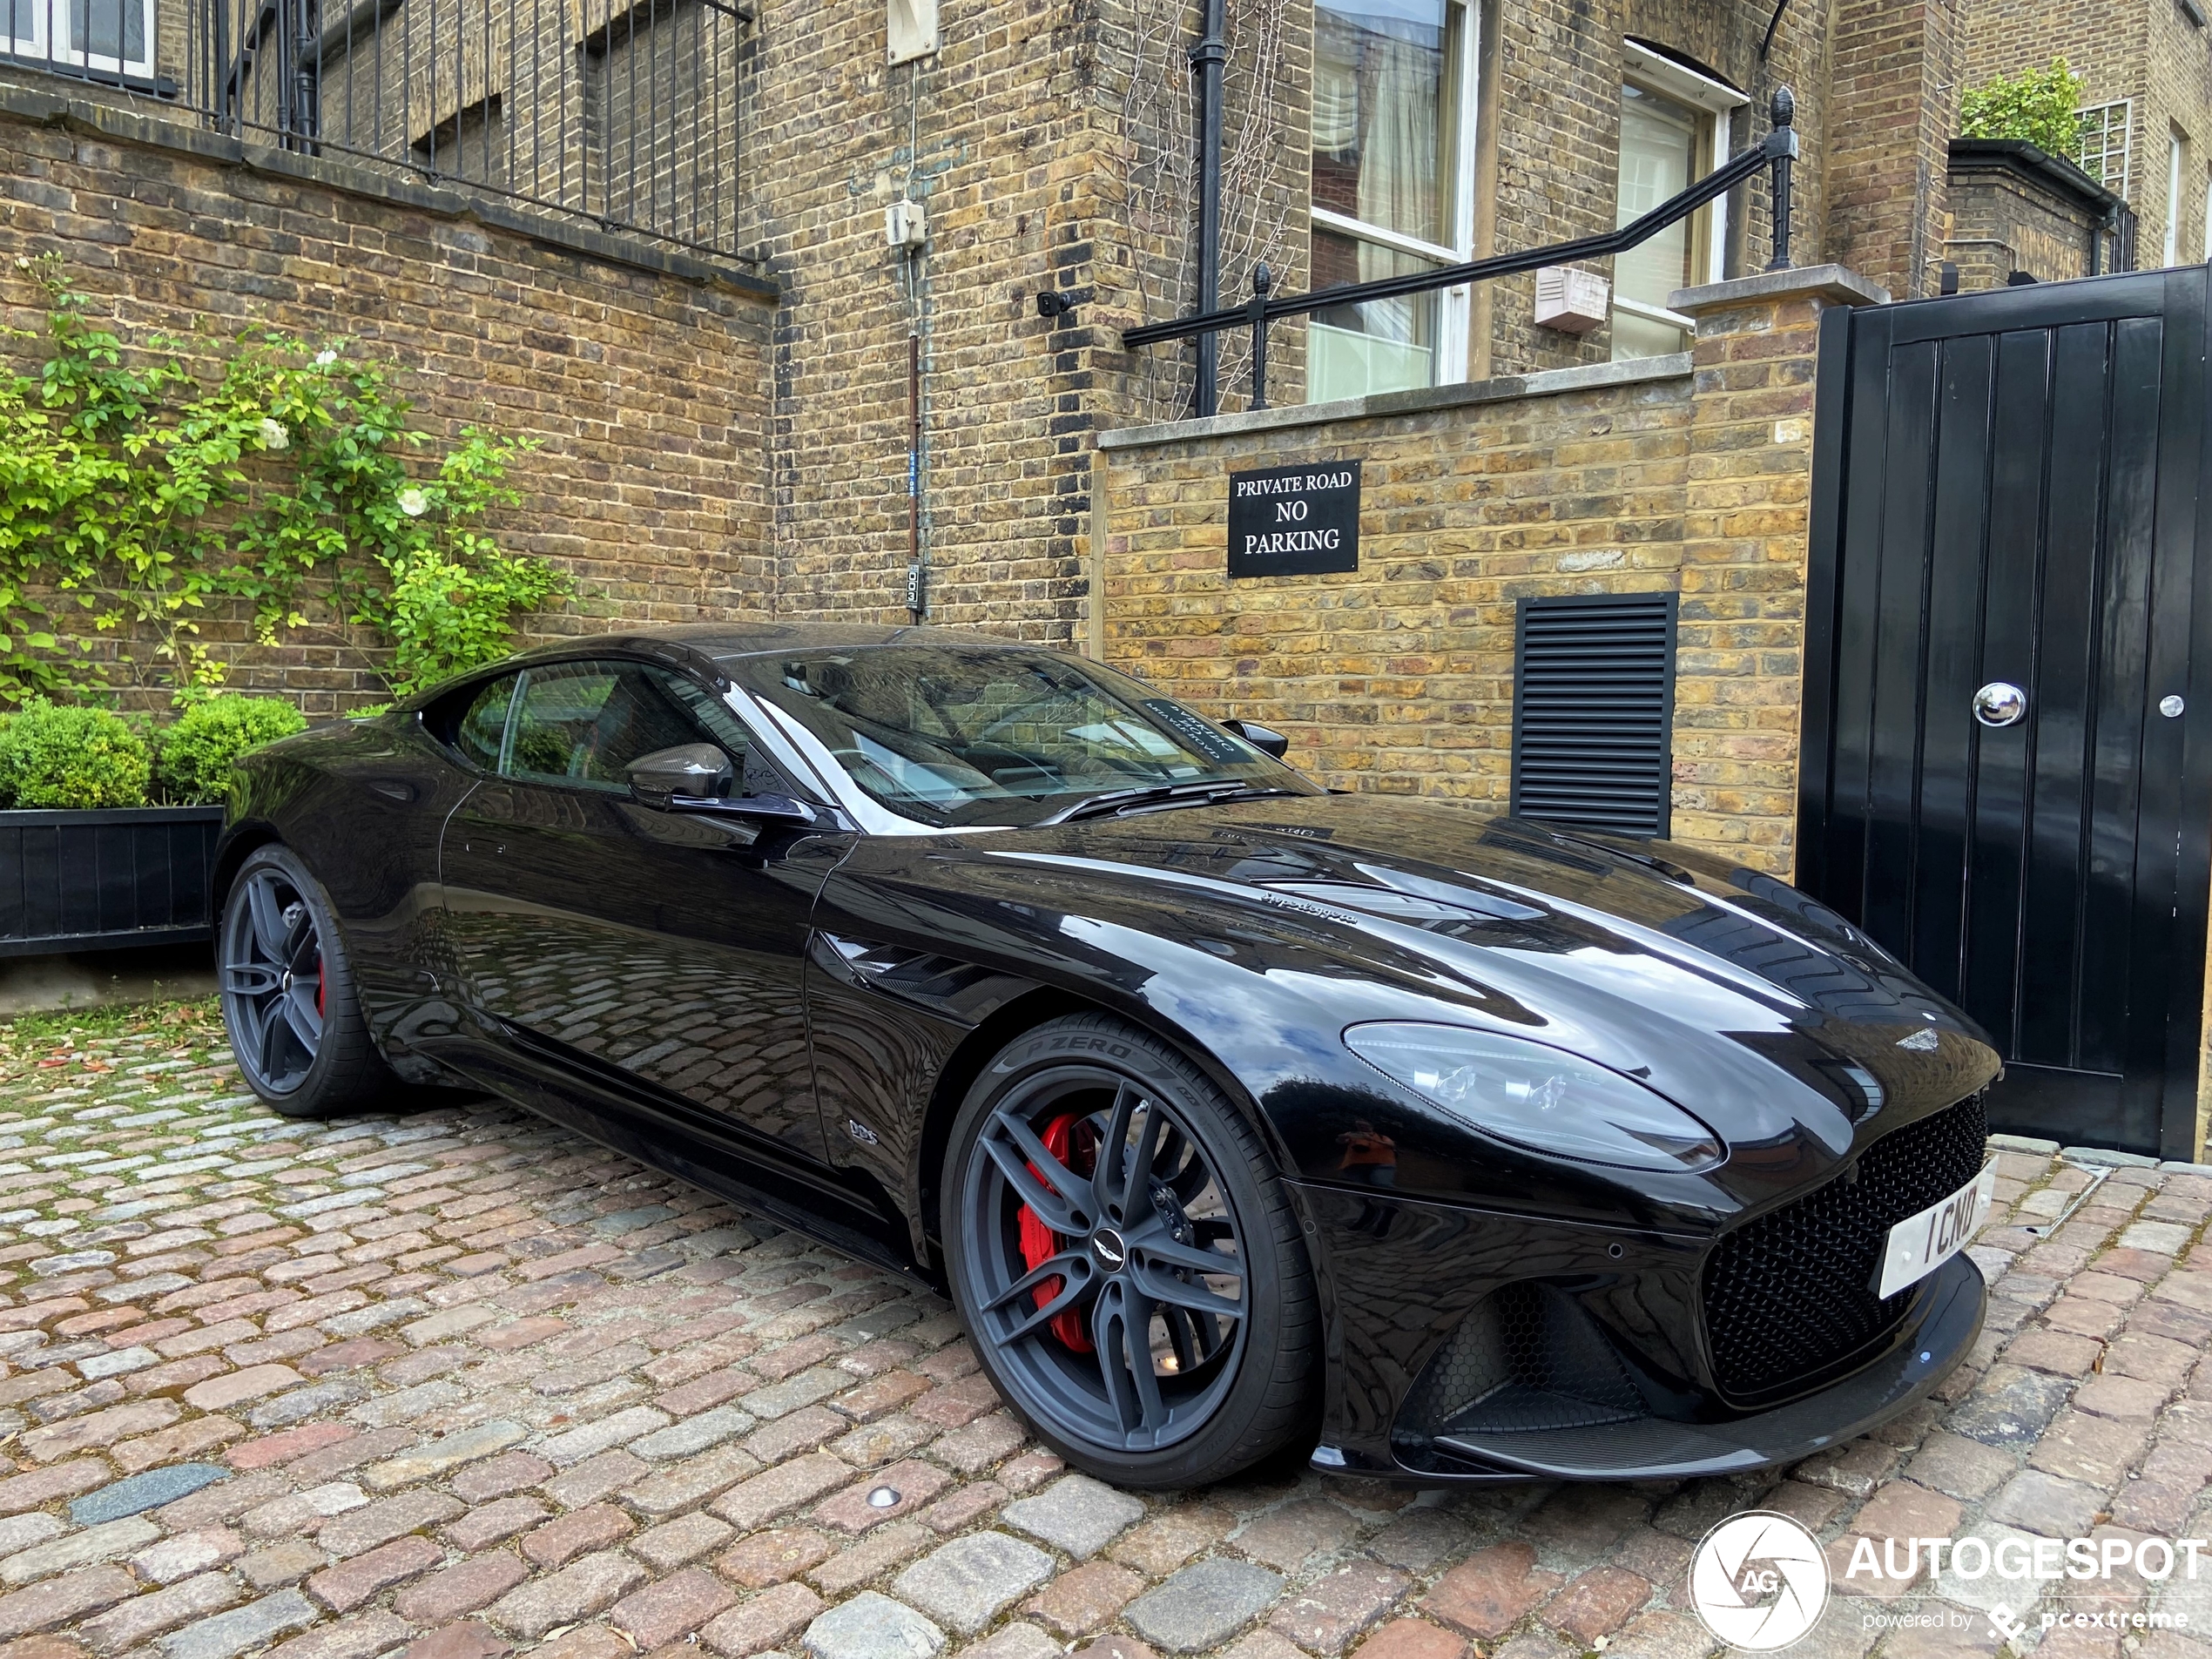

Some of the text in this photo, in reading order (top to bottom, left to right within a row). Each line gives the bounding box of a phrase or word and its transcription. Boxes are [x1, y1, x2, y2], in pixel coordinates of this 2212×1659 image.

[1237, 471, 1352, 497] PRIVATE ROAD
[1276, 500, 1308, 523] NO
[1244, 529, 1340, 555] PARKING
[907, 572, 917, 601] 003
[1027, 1036, 1133, 1059] P ZERO
